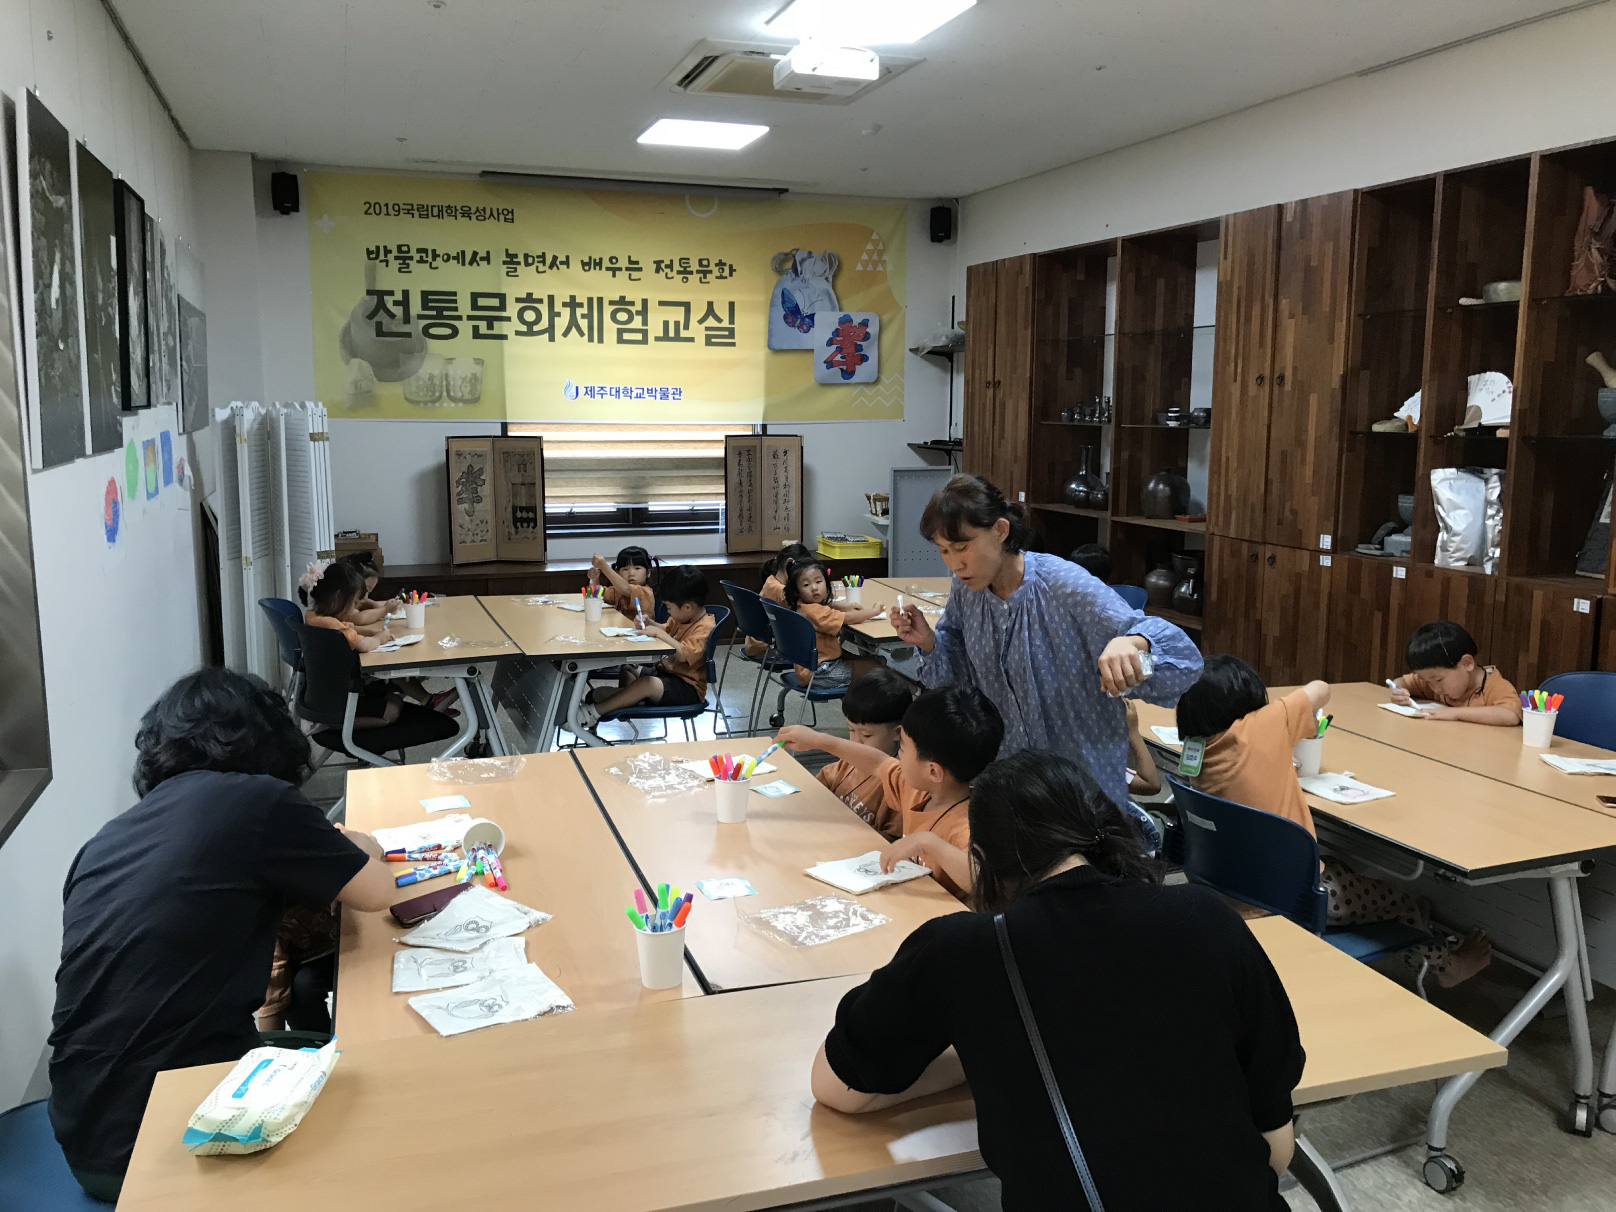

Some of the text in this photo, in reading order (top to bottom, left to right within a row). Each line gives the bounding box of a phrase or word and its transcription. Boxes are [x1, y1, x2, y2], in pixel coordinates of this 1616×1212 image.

[363, 201, 515, 224] 2019국립대학육성사업
[365, 243, 737, 285] 박물관에서 놀면서 배우는 전통문화
[365, 288, 737, 348] 전통문화체험교실
[583, 385, 683, 401] 제주대학교박물관
